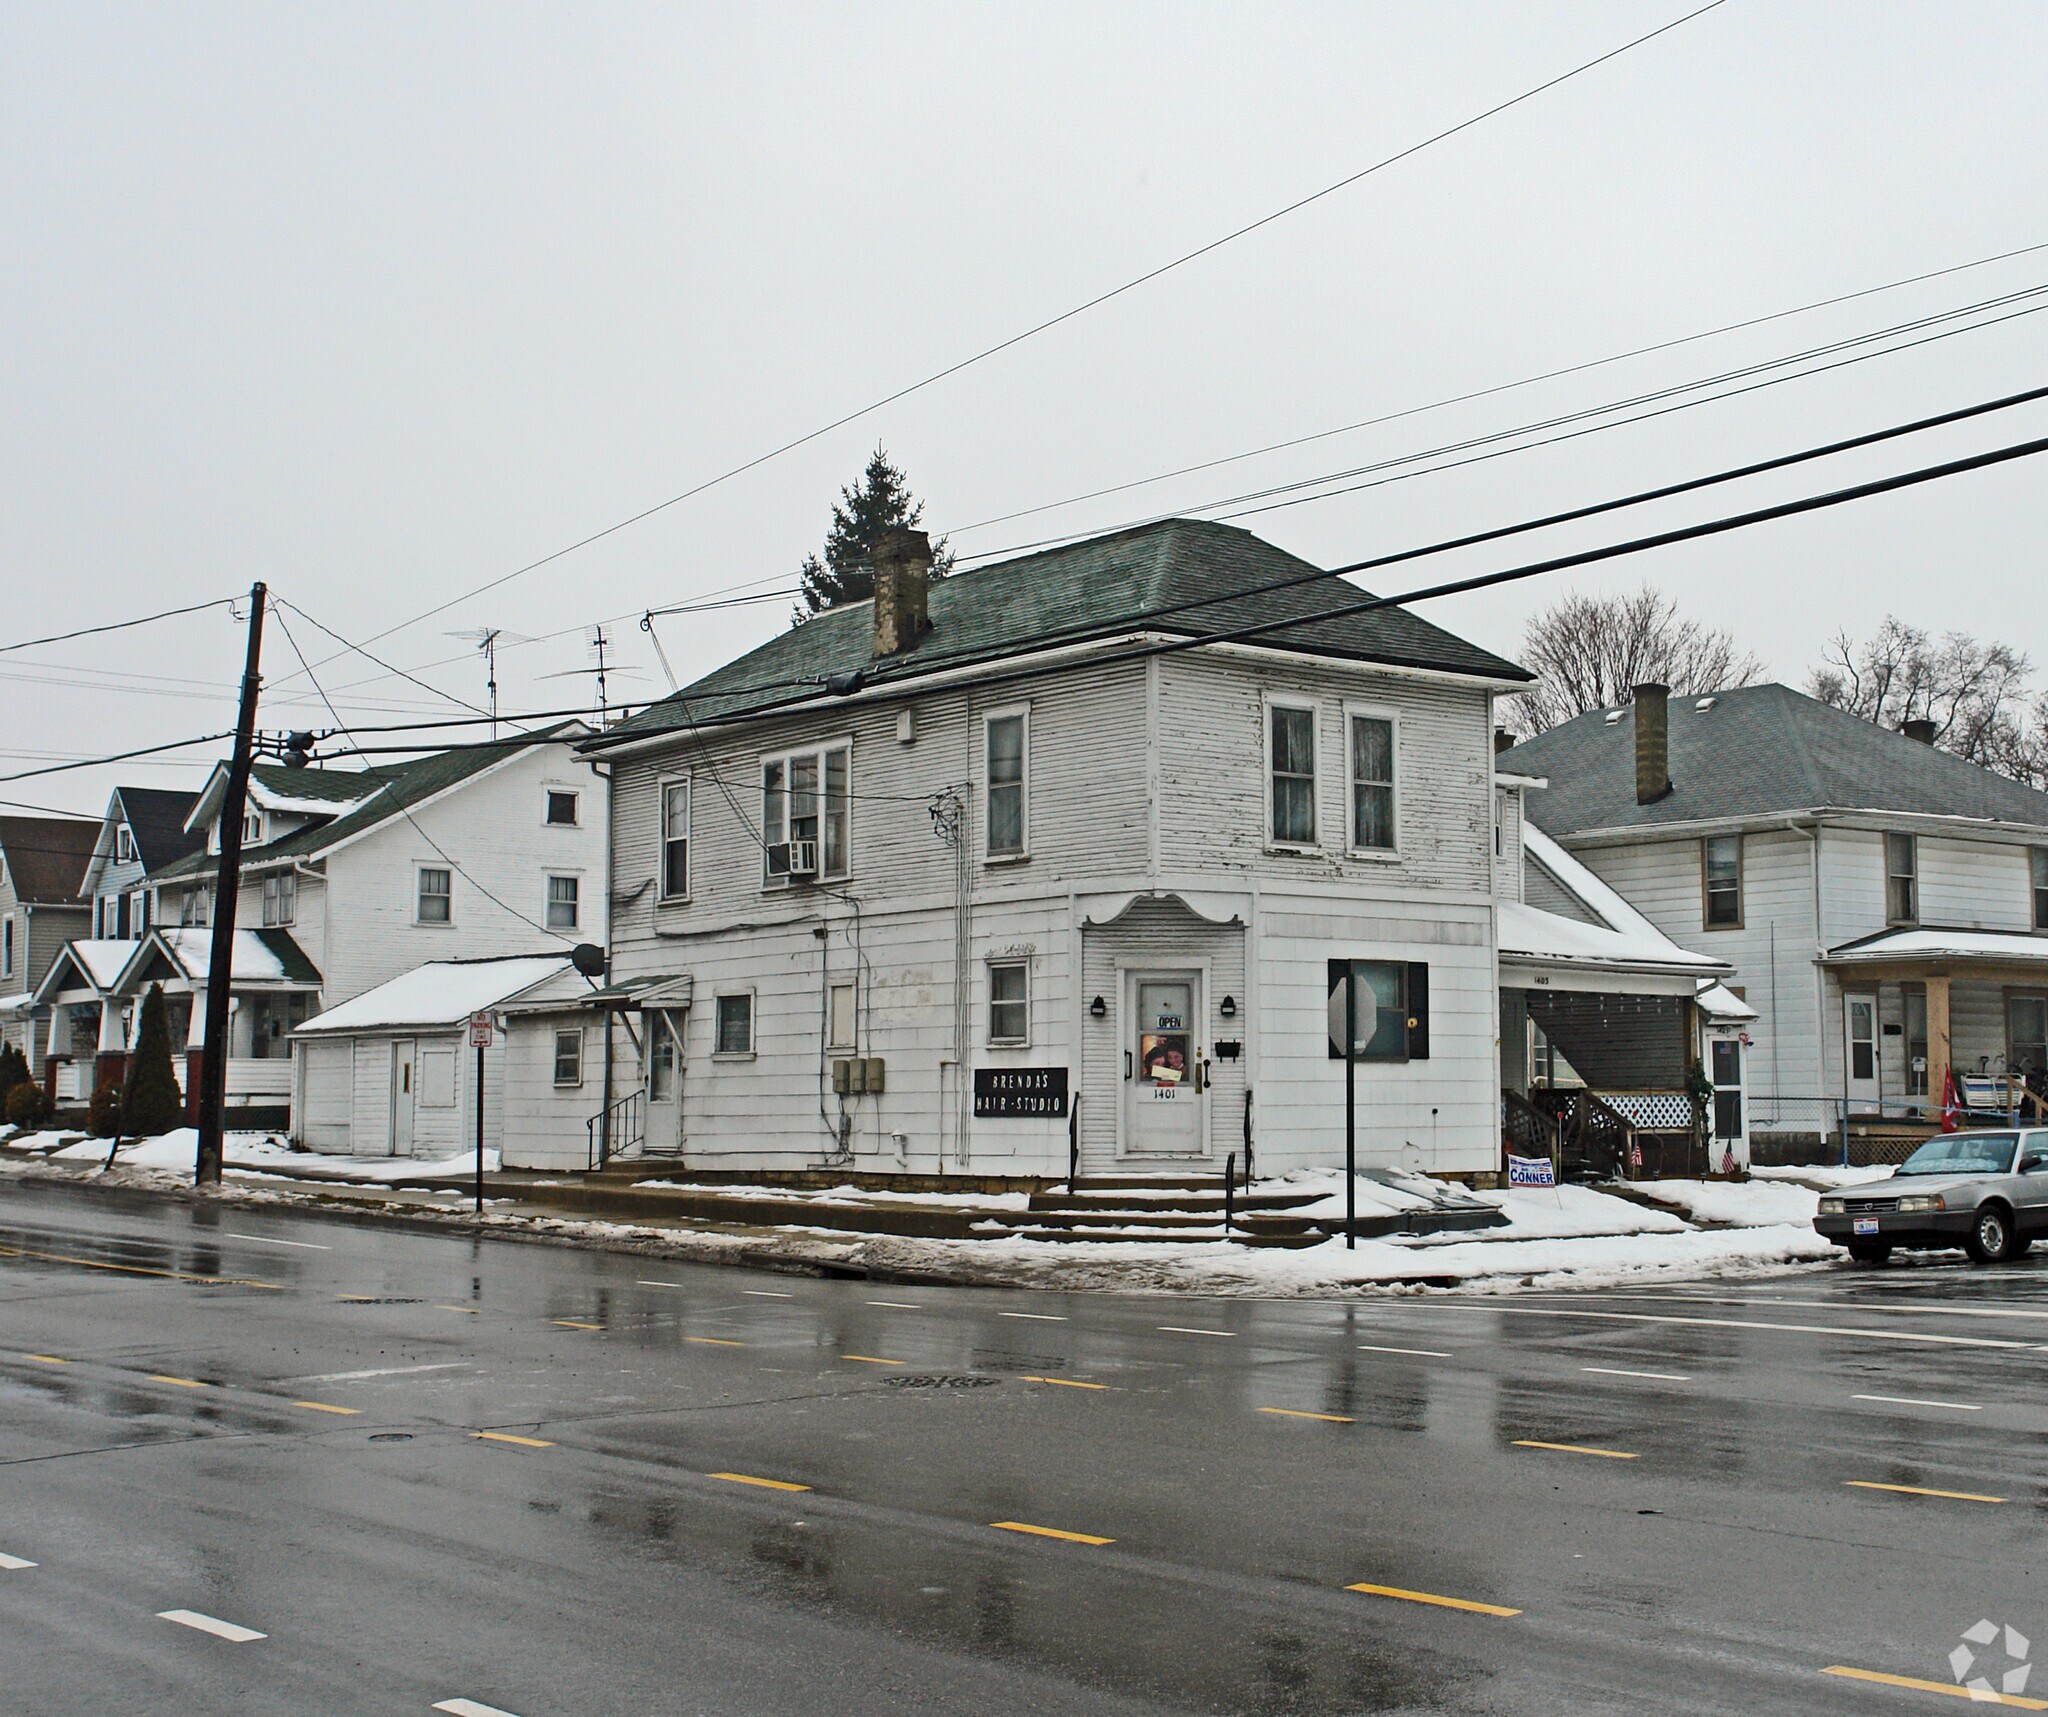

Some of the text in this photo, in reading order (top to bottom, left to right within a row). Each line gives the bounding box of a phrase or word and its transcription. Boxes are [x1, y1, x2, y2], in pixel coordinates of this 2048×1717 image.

[1159, 1017, 1181, 1027] OPEN
[1154, 1089, 1175, 1099] 1401
[1510, 1168, 1554, 1183] CONNER
